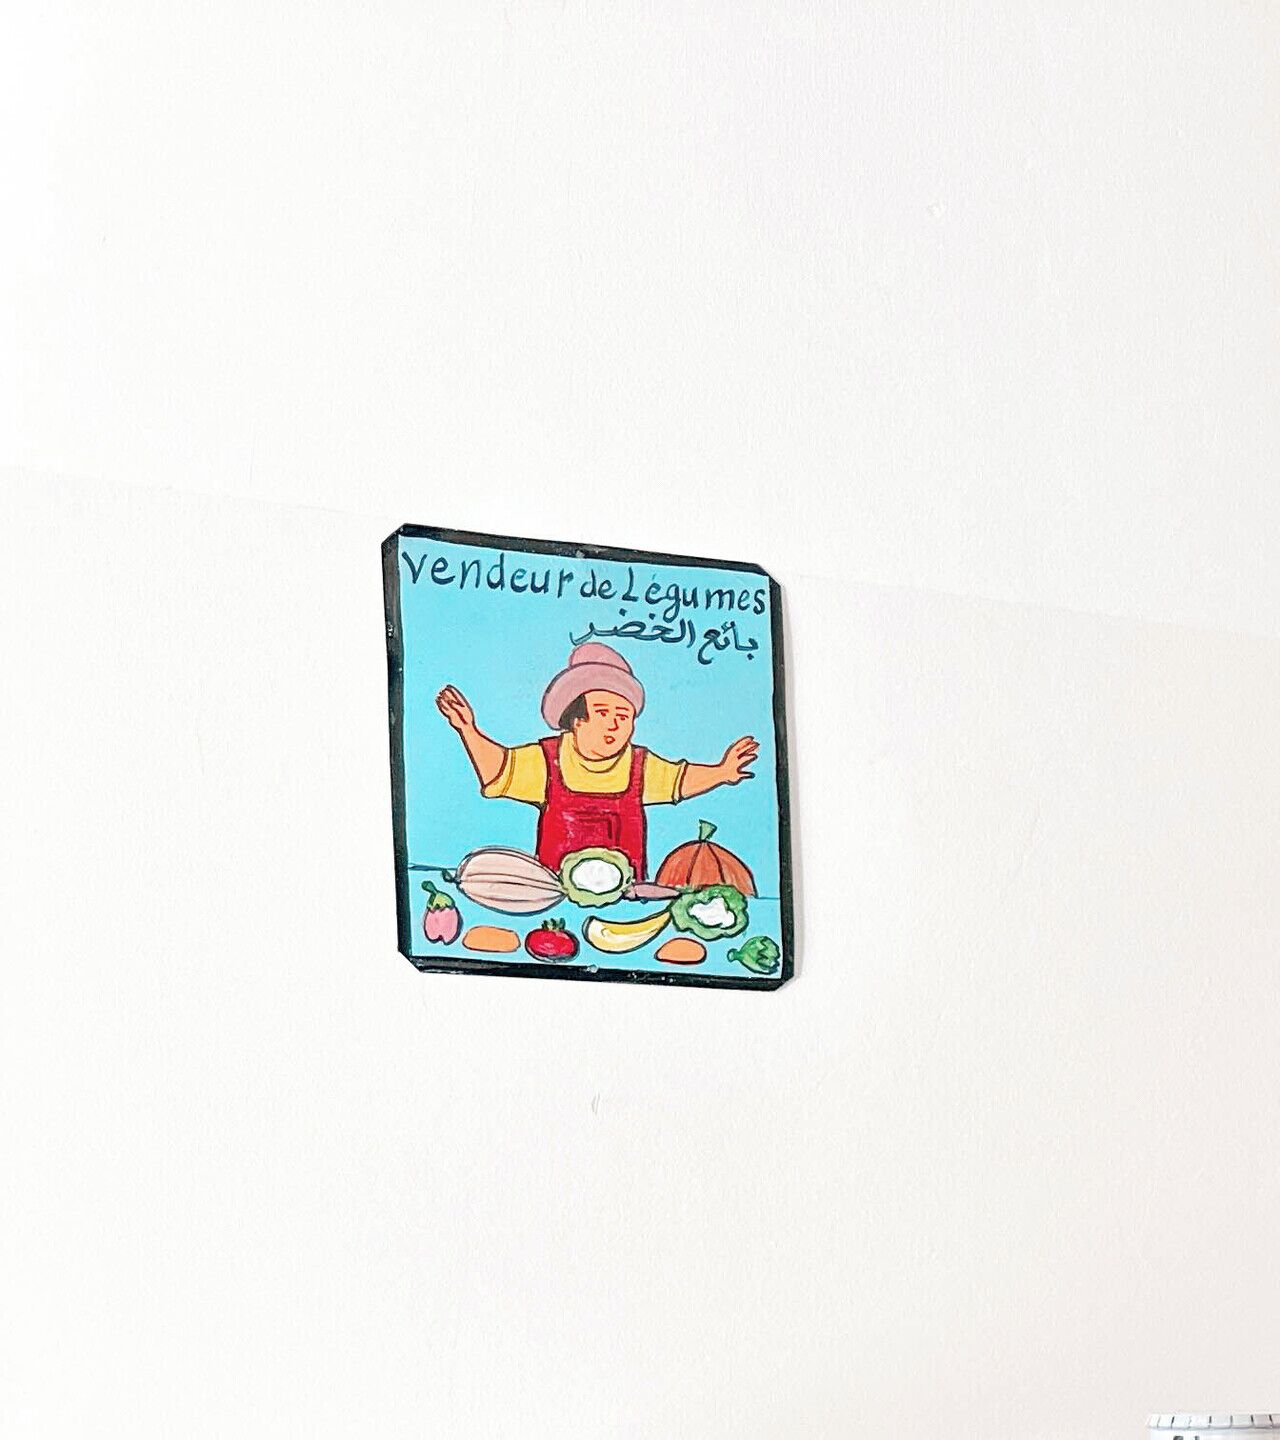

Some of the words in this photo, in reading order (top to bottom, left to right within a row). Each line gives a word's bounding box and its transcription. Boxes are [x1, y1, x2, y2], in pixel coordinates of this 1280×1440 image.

[401, 551, 572, 599] Vendeur
[579, 571, 618, 600] de
[622, 566, 767, 620] Légumes
